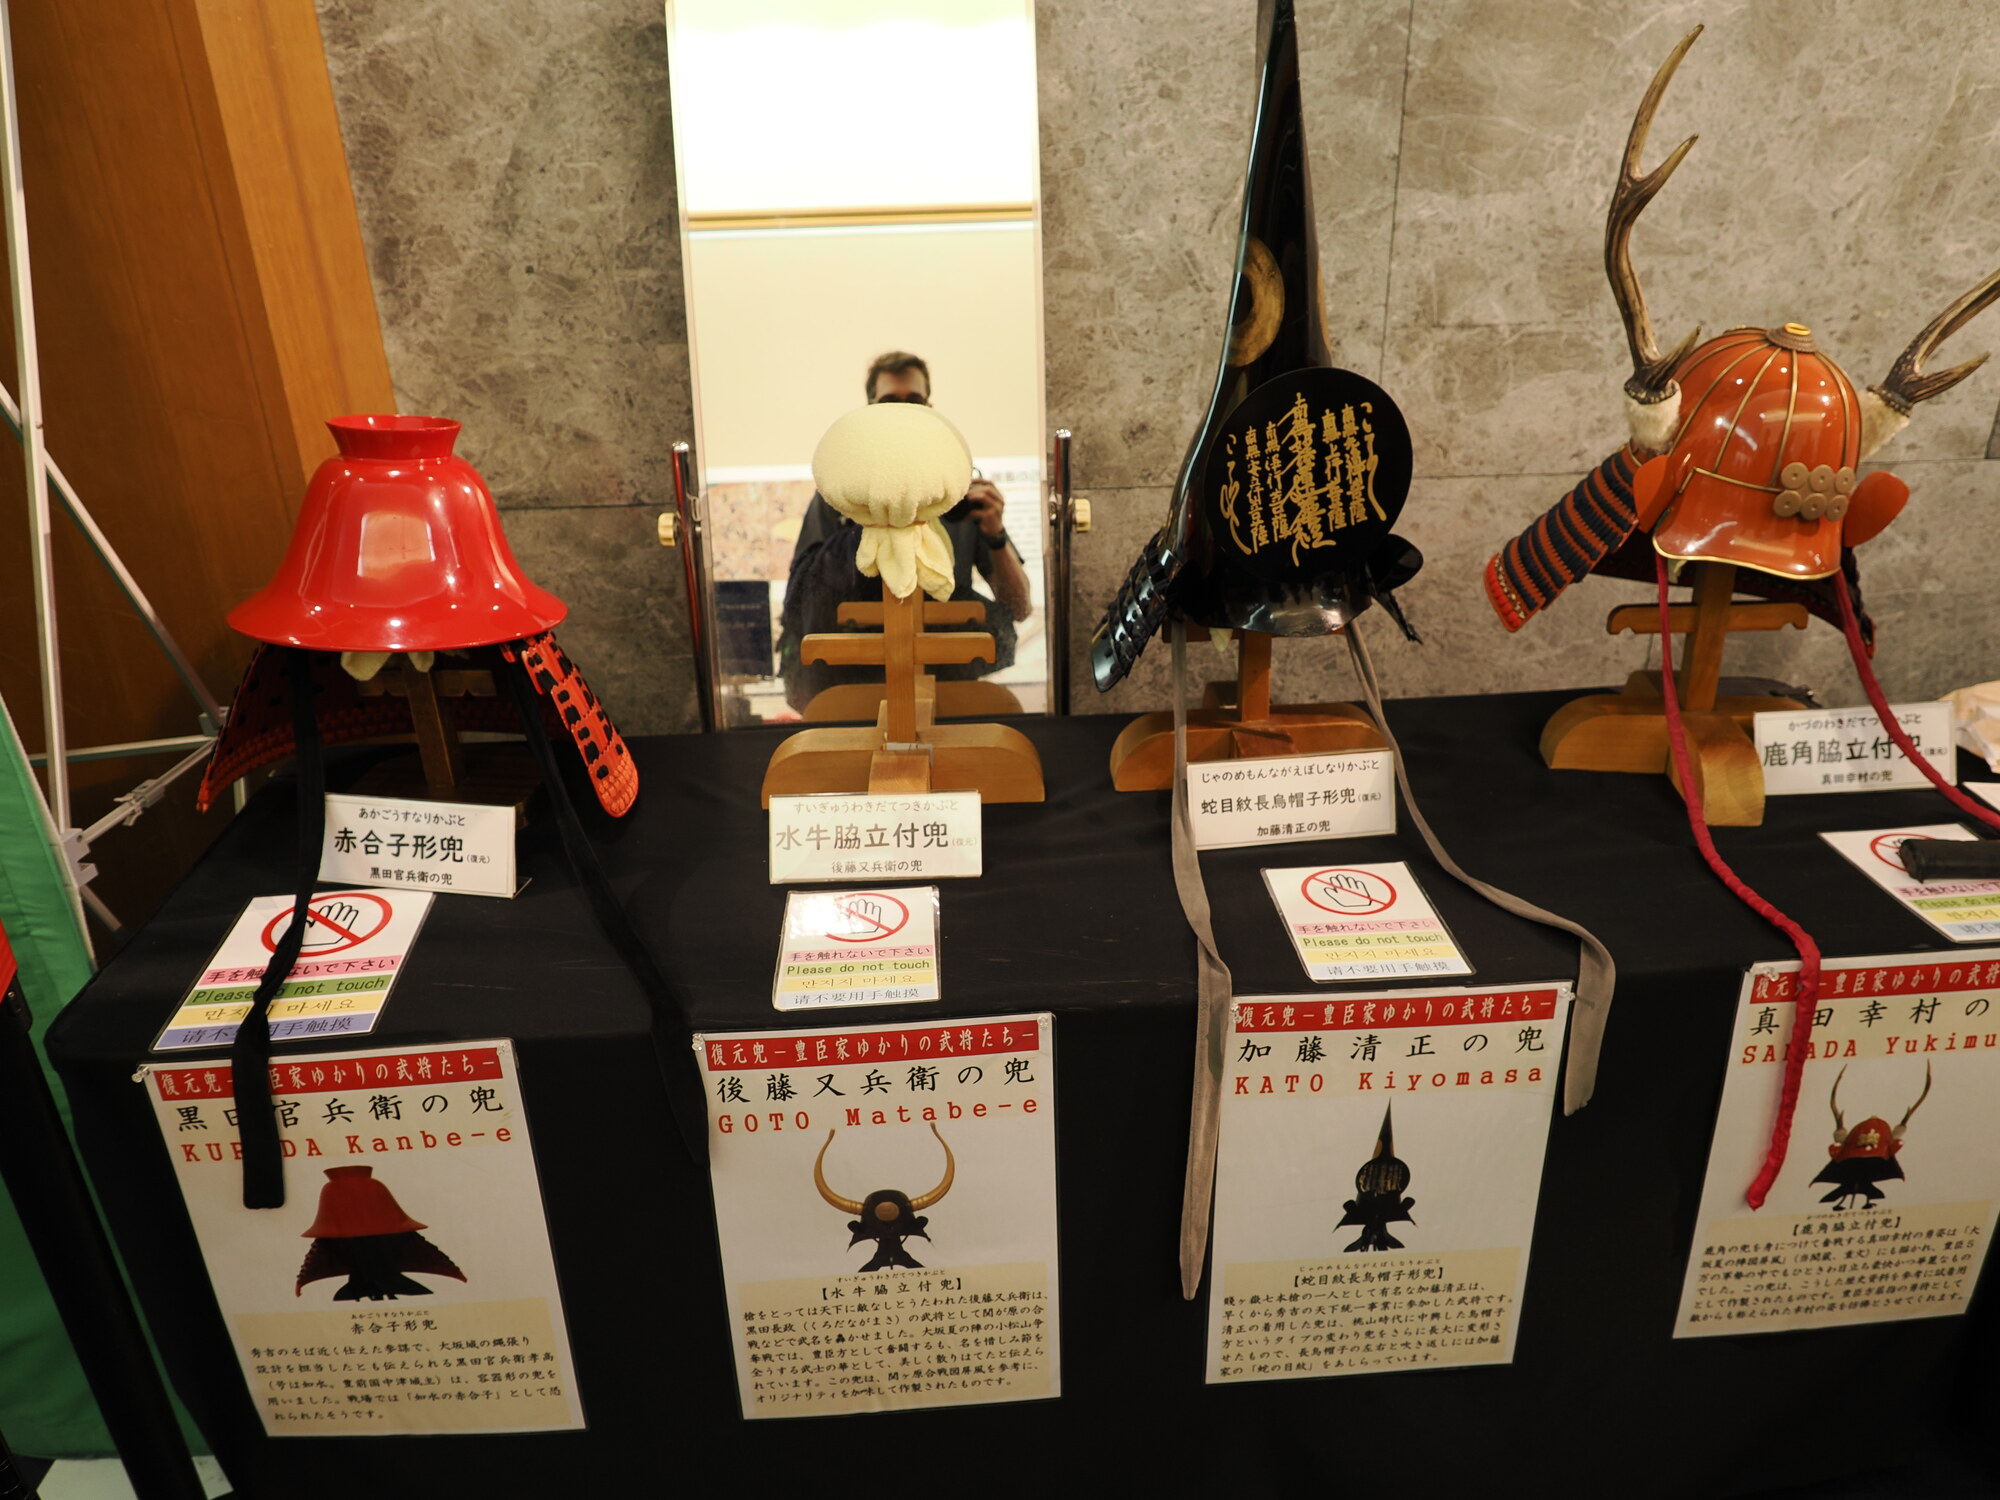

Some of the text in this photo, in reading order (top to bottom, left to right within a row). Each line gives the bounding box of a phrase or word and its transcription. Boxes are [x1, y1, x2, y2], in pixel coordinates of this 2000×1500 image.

[1788, 713, 1922, 730] かづのわきだてつぶと
[1201, 759, 1380, 783] じゃのめもんながえぼしなりかぶと
[794, 799, 959, 815] すいぎゅうわきだてつきかぶと
[1201, 788, 1356, 815] 蛇目紋長烏帽子形兜
[358, 807, 465, 826] あかごうすなりかぶと
[775, 821, 948, 851] 水牛脇立付兜
[1257, 820, 1330, 837] 加藤清正の兜
[334, 827, 464, 863] 赤合子形兜
[369, 866, 453, 885] 黒田官兵衛の兜
[831, 860, 922, 873] 後藤又兵衛の兜
[1297, 920, 1435, 934] 手を触れないで下さい
[1303, 931, 1443, 948] Please do not touch
[791, 947, 930, 961] 手を触れないで下さい
[206, 959, 396, 983] 手を触ないで下さい
[787, 960, 930, 975] Please do not touch
[1327, 961, 1450, 976] 请不要用手触摸
[192, 988, 254, 1003] Please
[294, 983, 325, 996] not
[336, 978, 385, 992] touch
[802, 977, 853, 989] 만지지
[794, 988, 920, 1005] 请不要用手触摸
[287, 999, 356, 1014] 마세요
[182, 1017, 352, 1044] 请不手触摸
[1237, 1026, 1545, 1063] 加藤清正の兜
[1742, 1032, 1997, 1064] SAADA Yukimu
[161, 1056, 494, 1096] 復元兜臣家ゆかりの武将たちー
[717, 1057, 1035, 1103] 後藤又兵衛の兜
[1234, 1067, 1542, 1095] KATO Kiyomasa
[718, 1098, 1038, 1135] GOTO Matabe-e
[181, 1128, 512, 1162] KURDA Kanbe-e
[351, 1319, 437, 1334] 赤合子形兜
